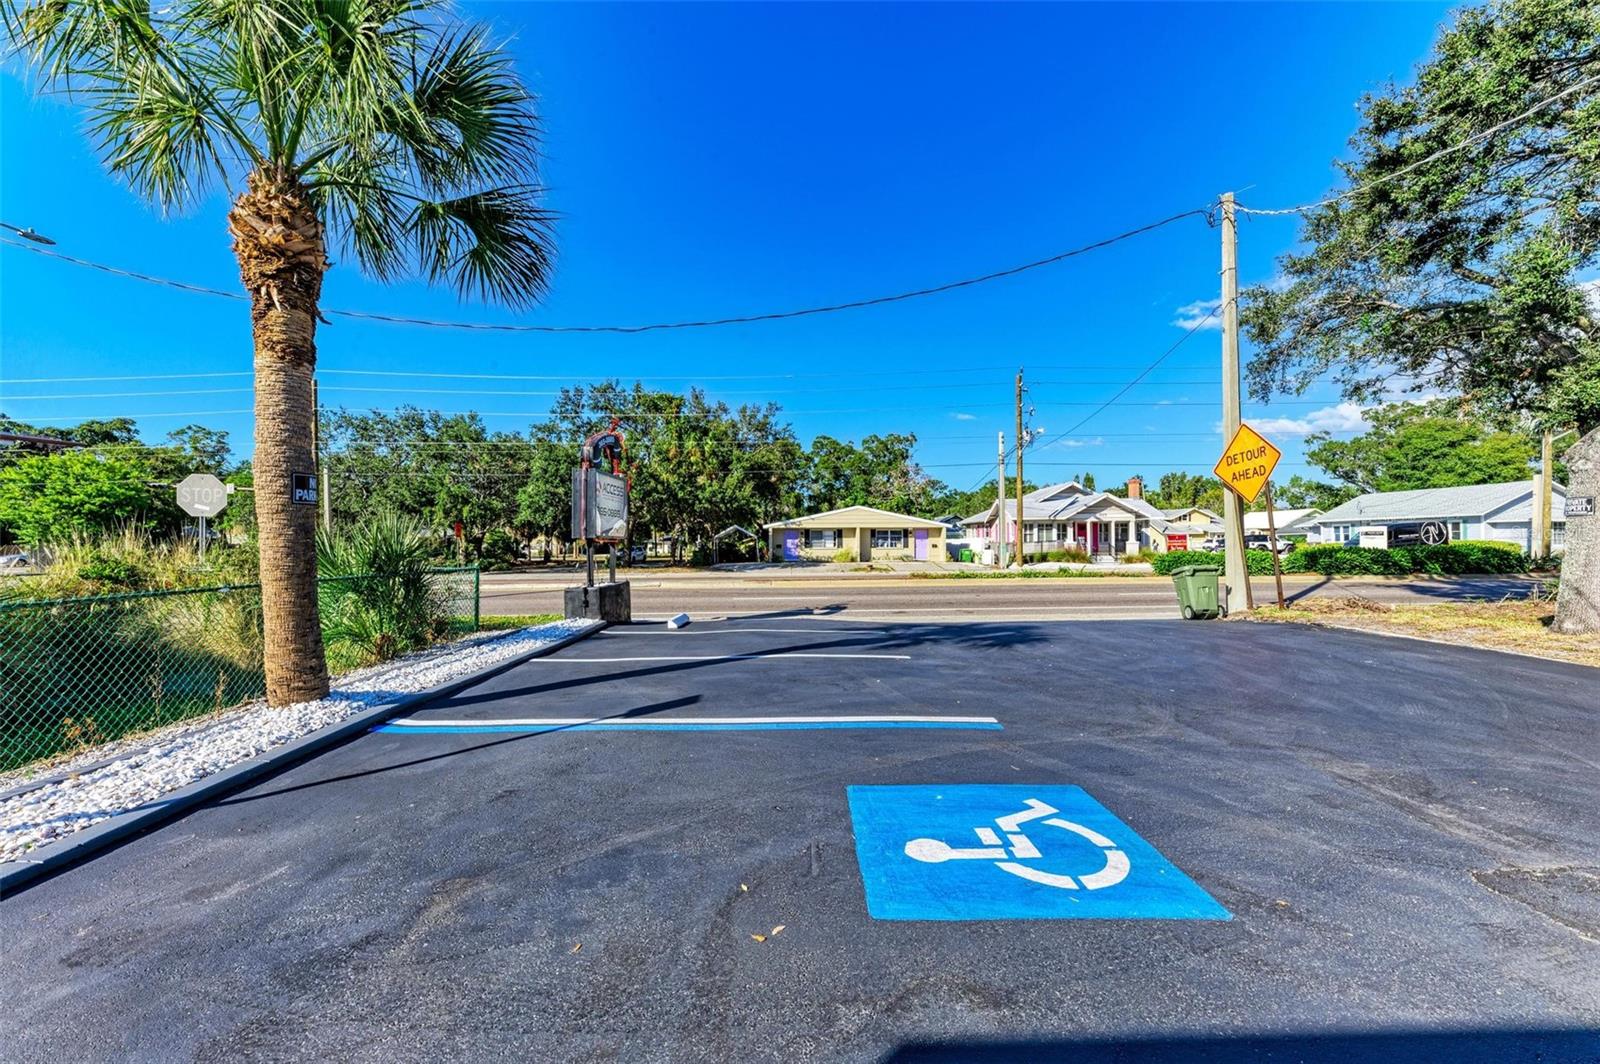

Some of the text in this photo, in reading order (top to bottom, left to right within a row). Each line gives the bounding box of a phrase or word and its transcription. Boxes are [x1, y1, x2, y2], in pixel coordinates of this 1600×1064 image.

[1226, 446, 1267, 467] DETOUR
[1231, 464, 1267, 483] AHEAD
[181, 488, 223, 502] STOP
[602, 481, 624, 497] ACCESS
